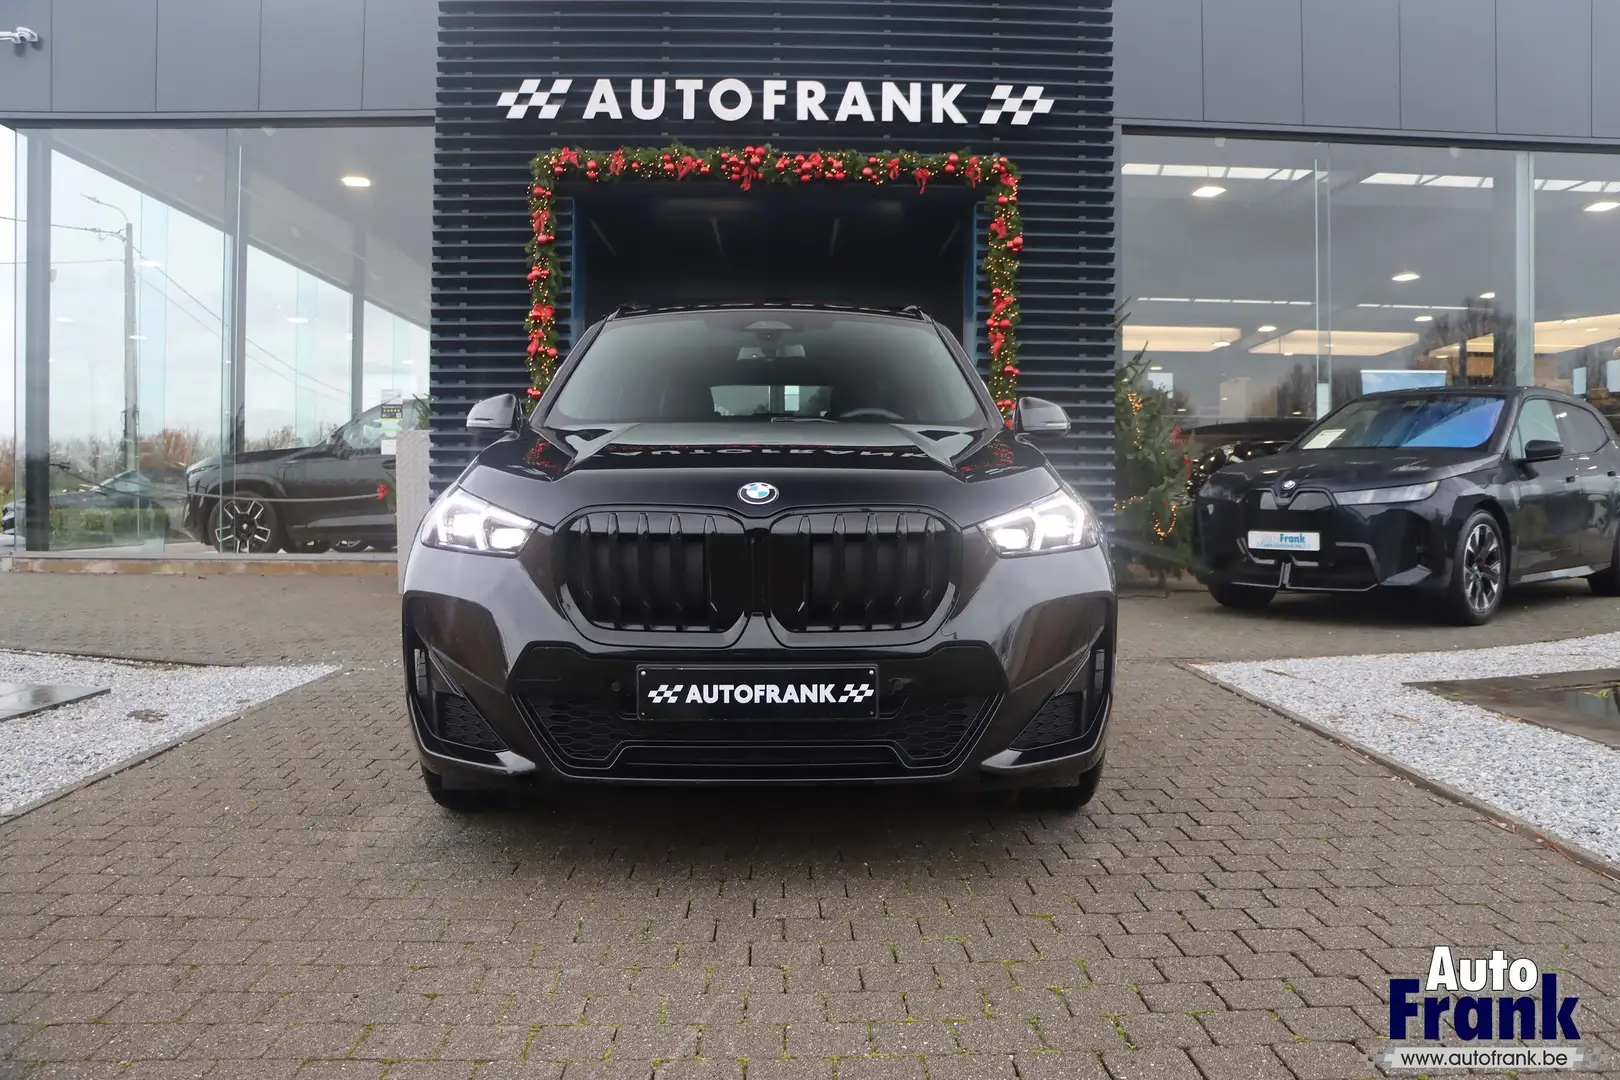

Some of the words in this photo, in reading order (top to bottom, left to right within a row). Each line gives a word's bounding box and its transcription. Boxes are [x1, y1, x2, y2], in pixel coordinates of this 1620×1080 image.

[583, 78, 968, 124] AUTOFRANK
[1280, 533, 1305, 543] Frank
[685, 684, 837, 704] AUTOFRANK
